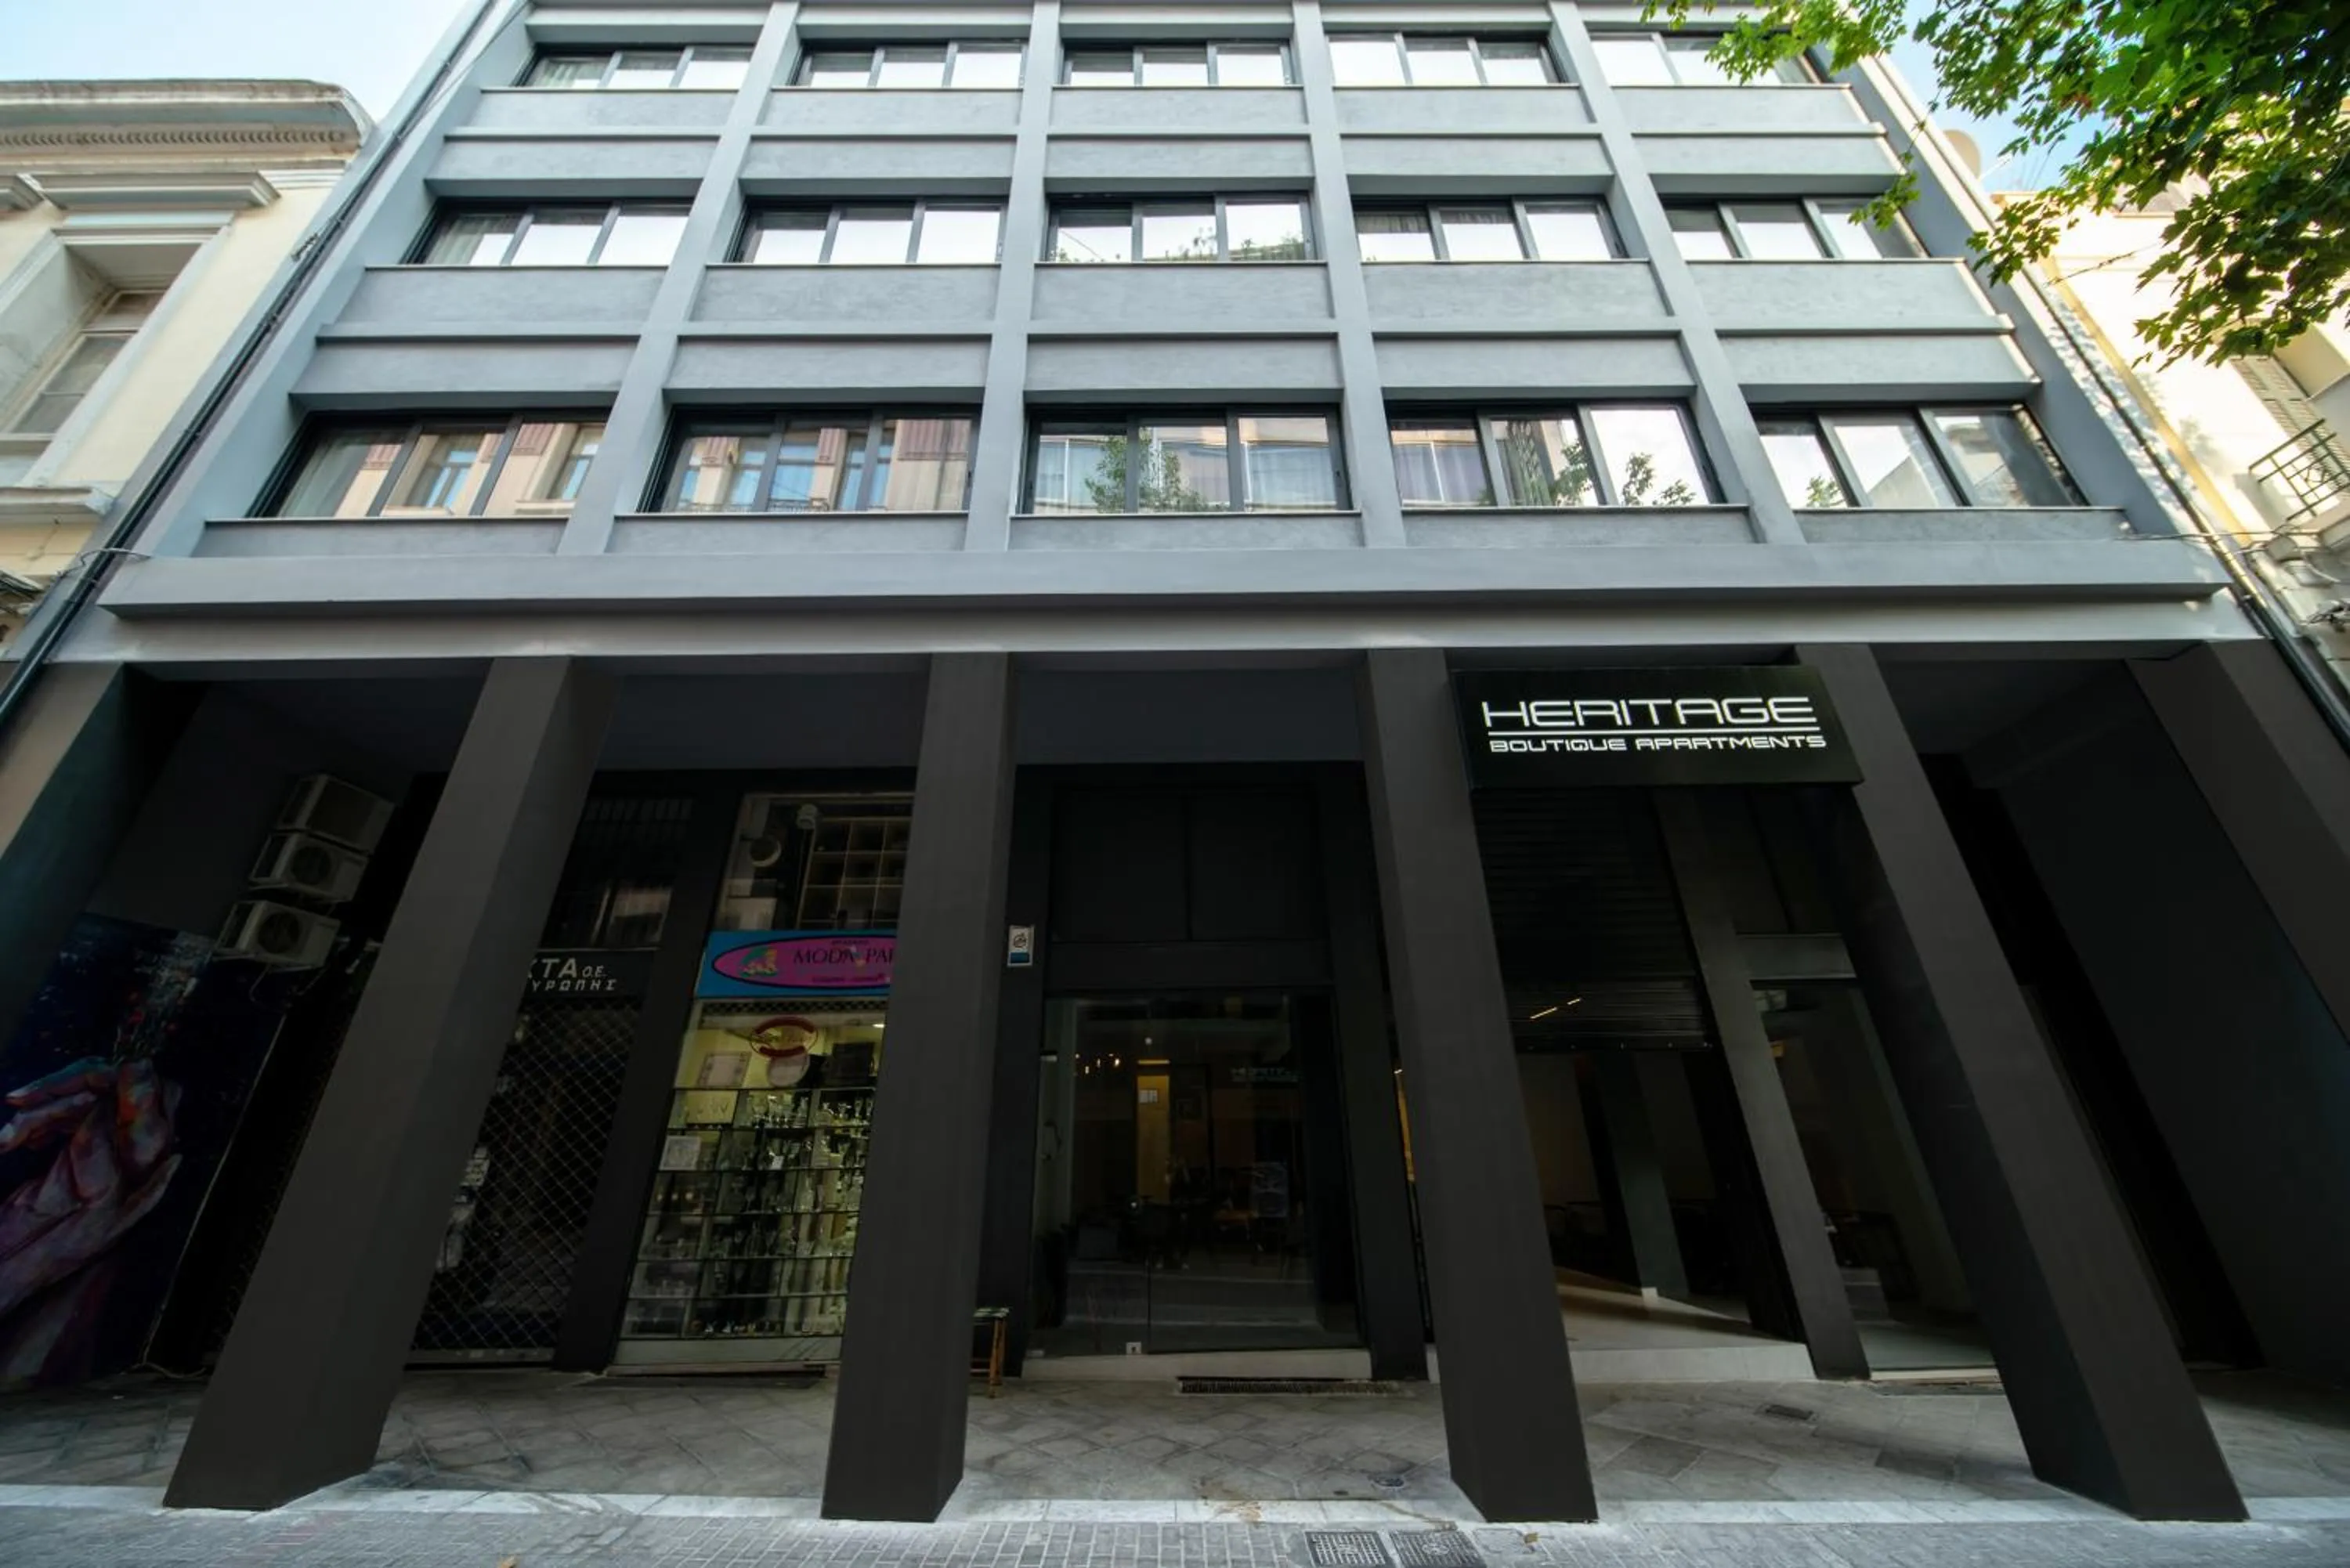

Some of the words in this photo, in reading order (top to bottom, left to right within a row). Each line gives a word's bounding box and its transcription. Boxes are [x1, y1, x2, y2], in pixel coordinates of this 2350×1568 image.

[1481, 696, 1818, 728] HERITAGE
[1490, 738, 1628, 753] BOUTIQUE
[1636, 735, 1828, 751] APARTMENTS
